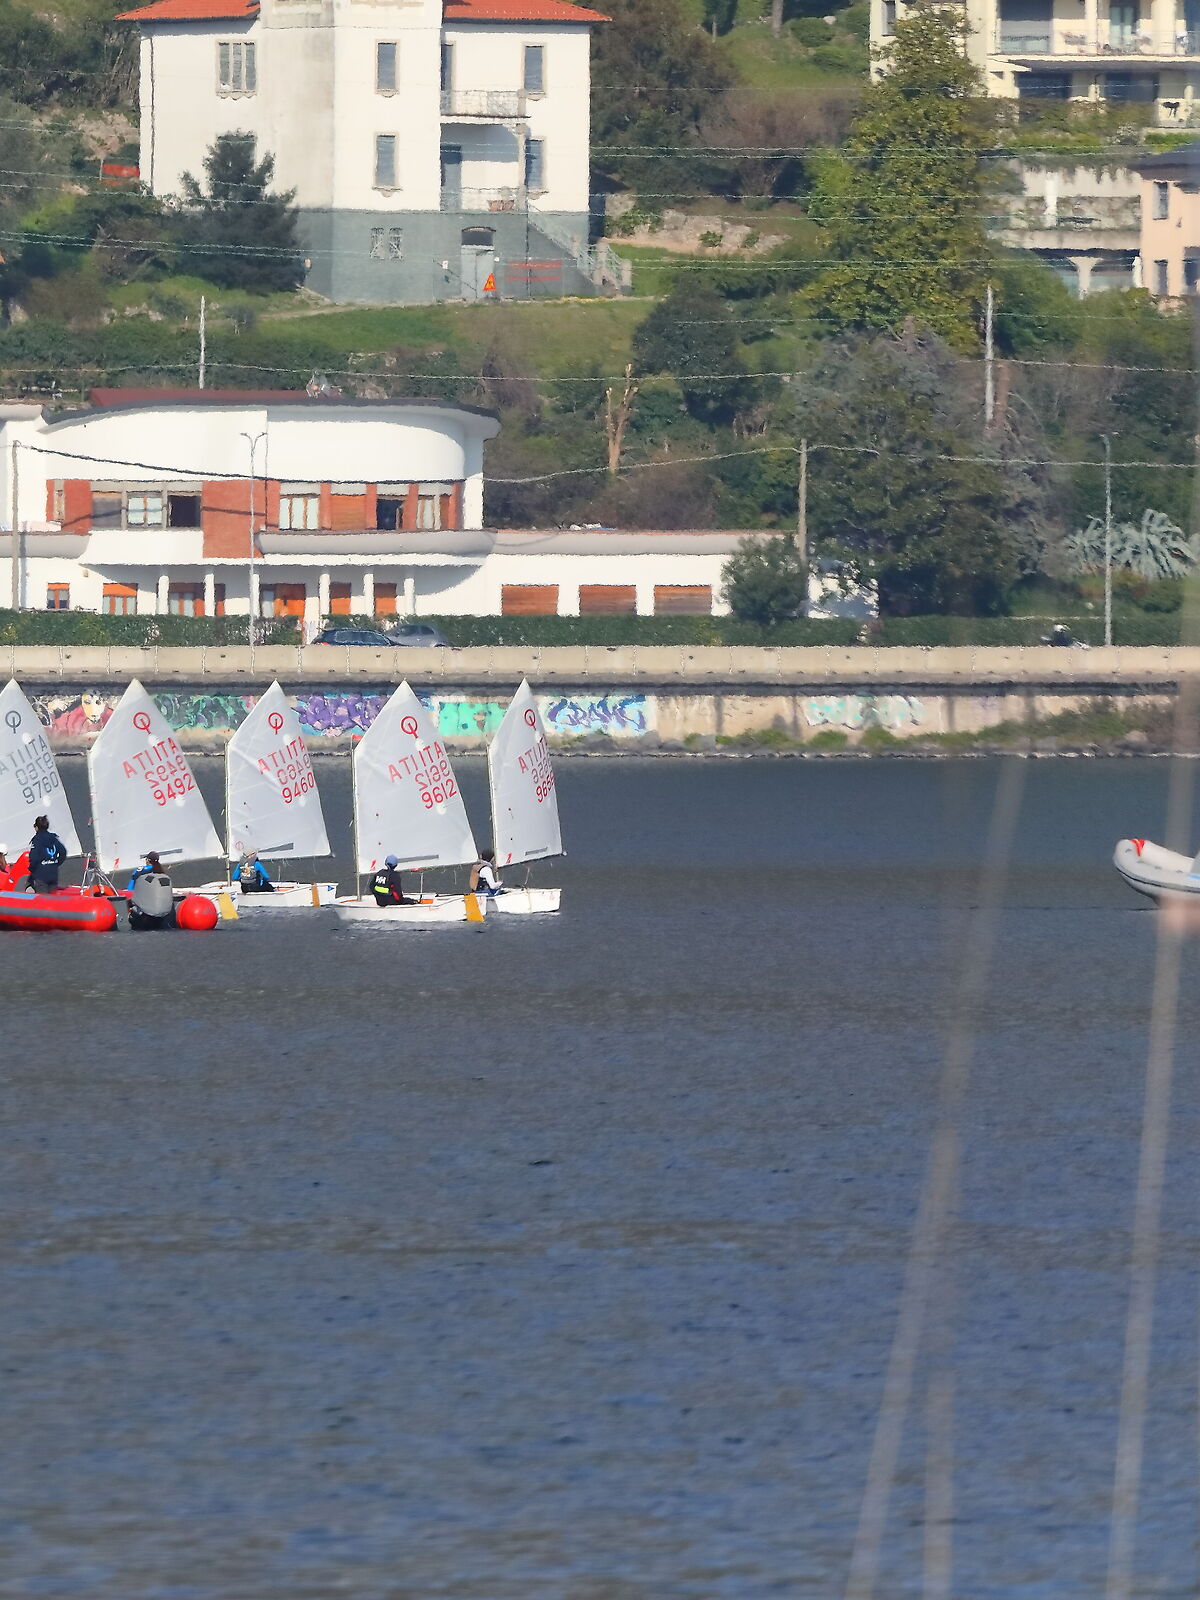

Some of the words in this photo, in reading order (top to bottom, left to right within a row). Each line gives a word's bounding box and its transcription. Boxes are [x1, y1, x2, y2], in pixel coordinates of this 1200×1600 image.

[153, 773, 196, 807] 9492
[282, 772, 315, 804] 9460
[421, 778, 457, 810] 9612
